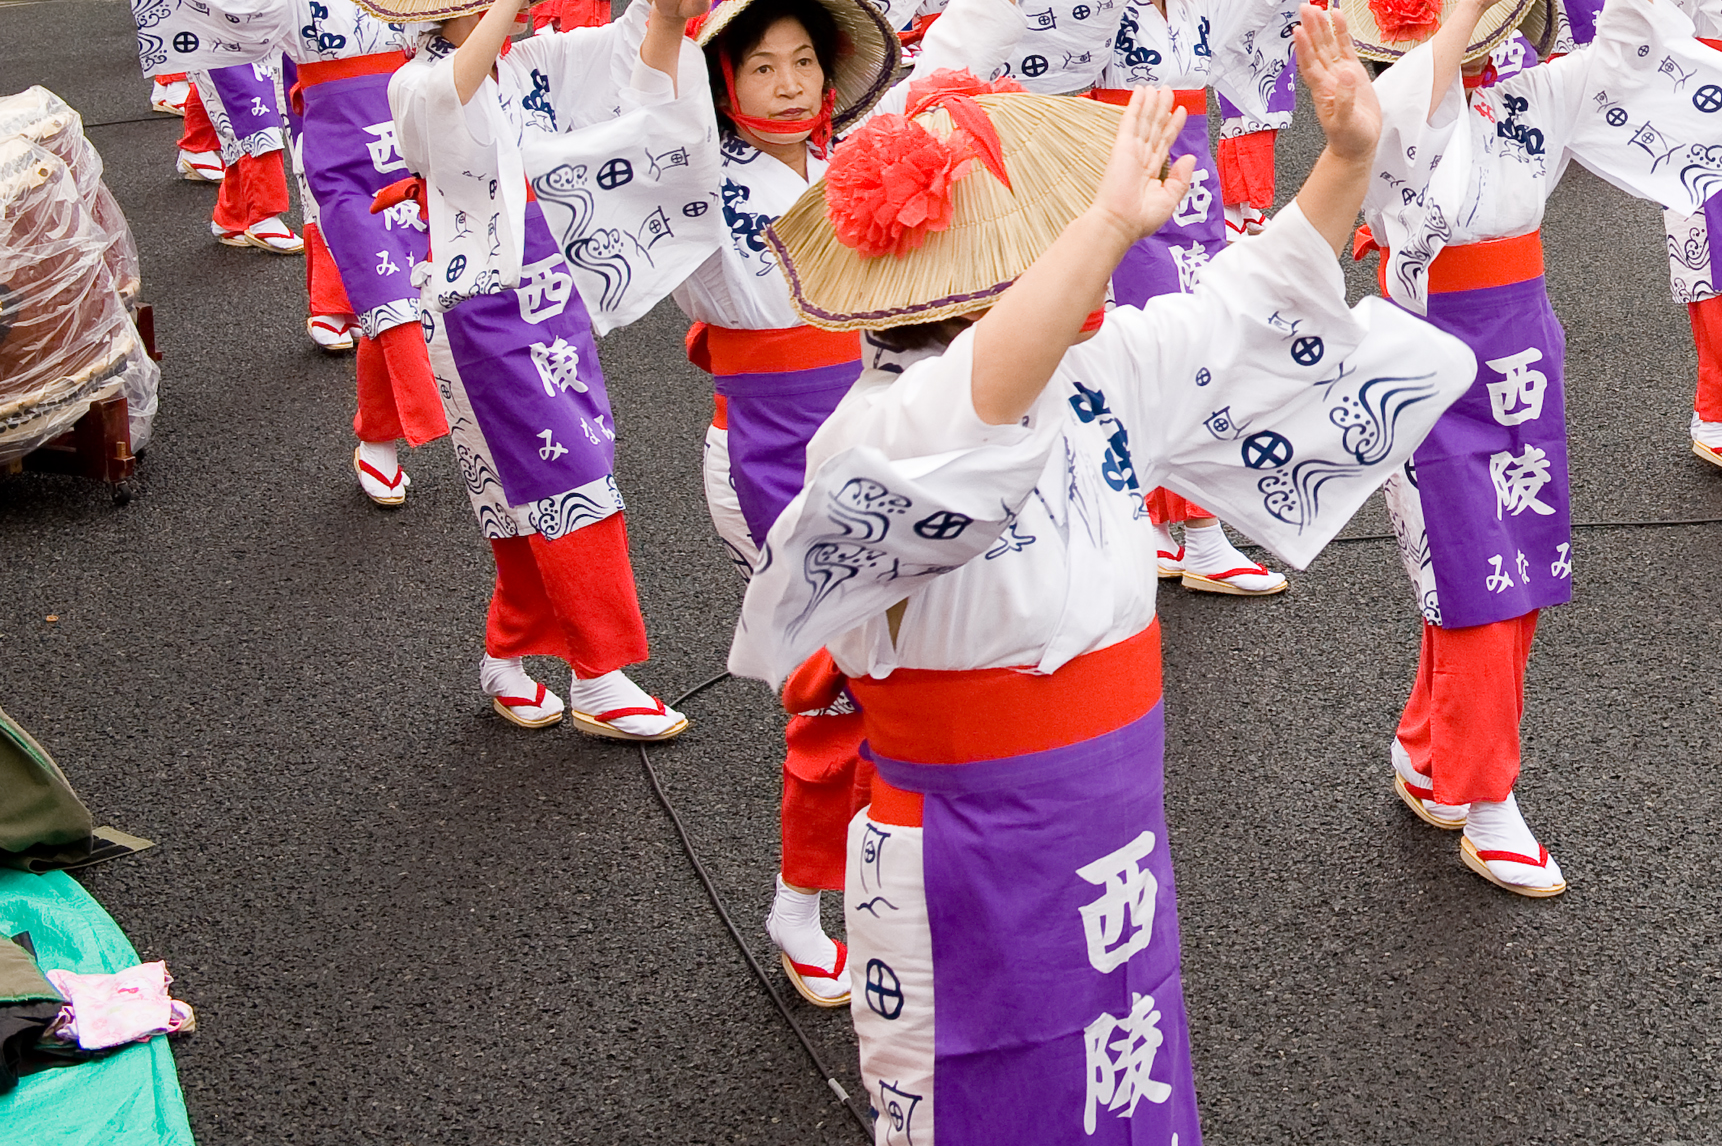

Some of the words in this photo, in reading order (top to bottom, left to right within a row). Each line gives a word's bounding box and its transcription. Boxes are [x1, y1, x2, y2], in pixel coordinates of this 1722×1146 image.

[514, 252, 589, 398] 西陵
[1484, 346, 1557, 522] 西陵
[1075, 830, 1172, 1135] 西陵
